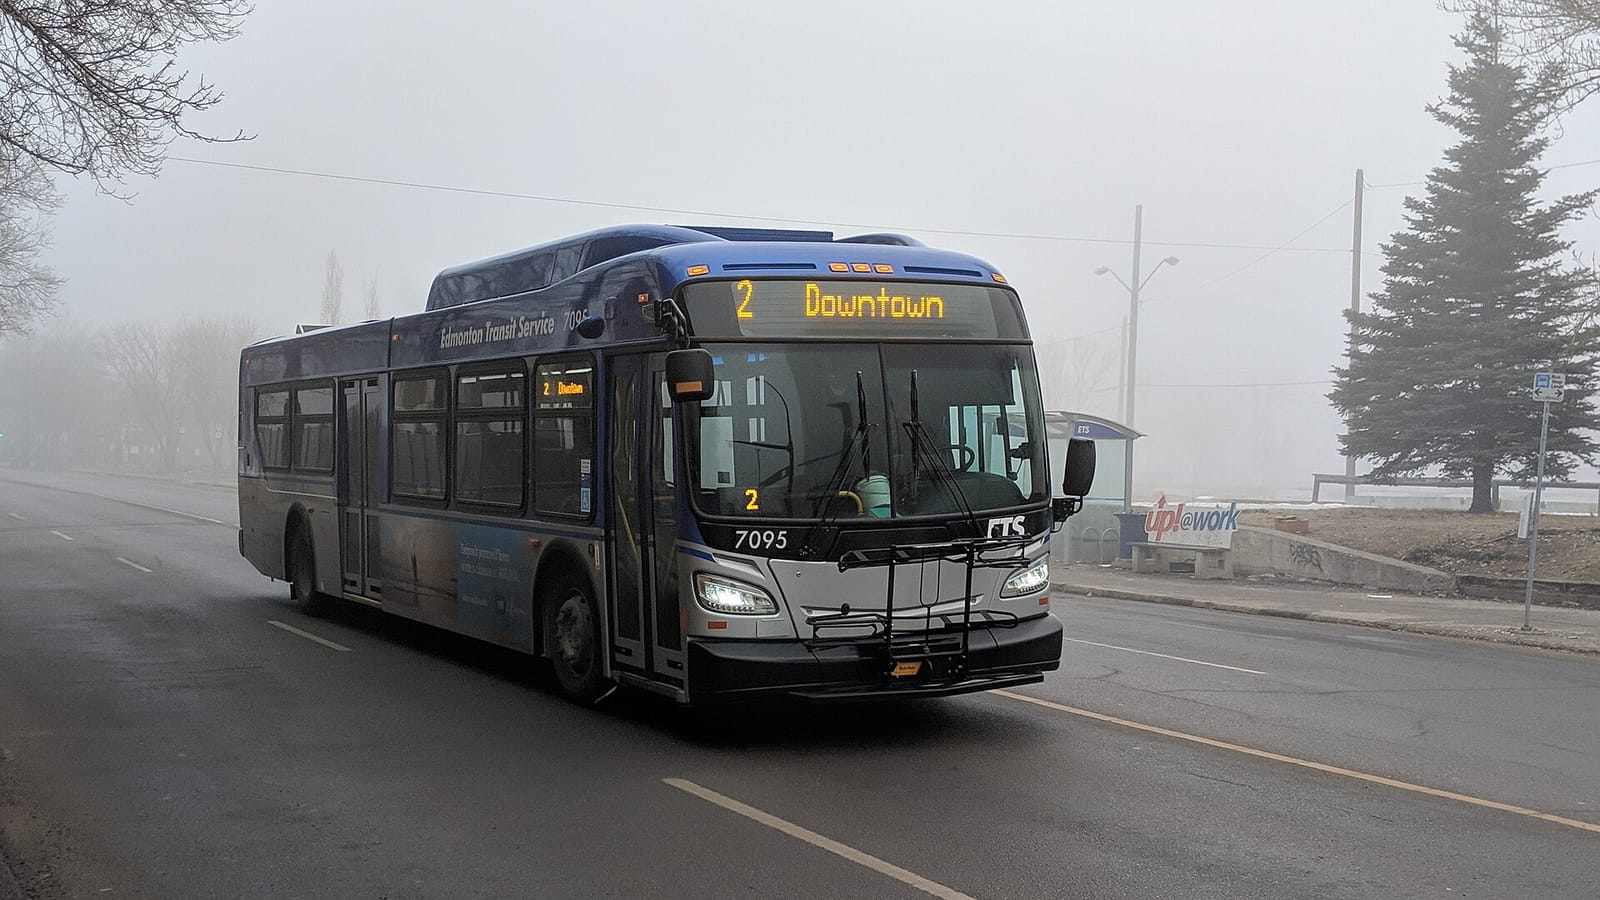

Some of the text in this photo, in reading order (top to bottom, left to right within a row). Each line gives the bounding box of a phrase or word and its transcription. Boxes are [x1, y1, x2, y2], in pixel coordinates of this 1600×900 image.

[737, 280, 945, 319] 2 Downtown
[440, 311, 555, 349] Edmonton Transit Service
[543, 382, 550, 396] 2
[1077, 425, 1090, 434] ETS
[744, 488, 760, 511] 2
[735, 530, 788, 551] 7095
